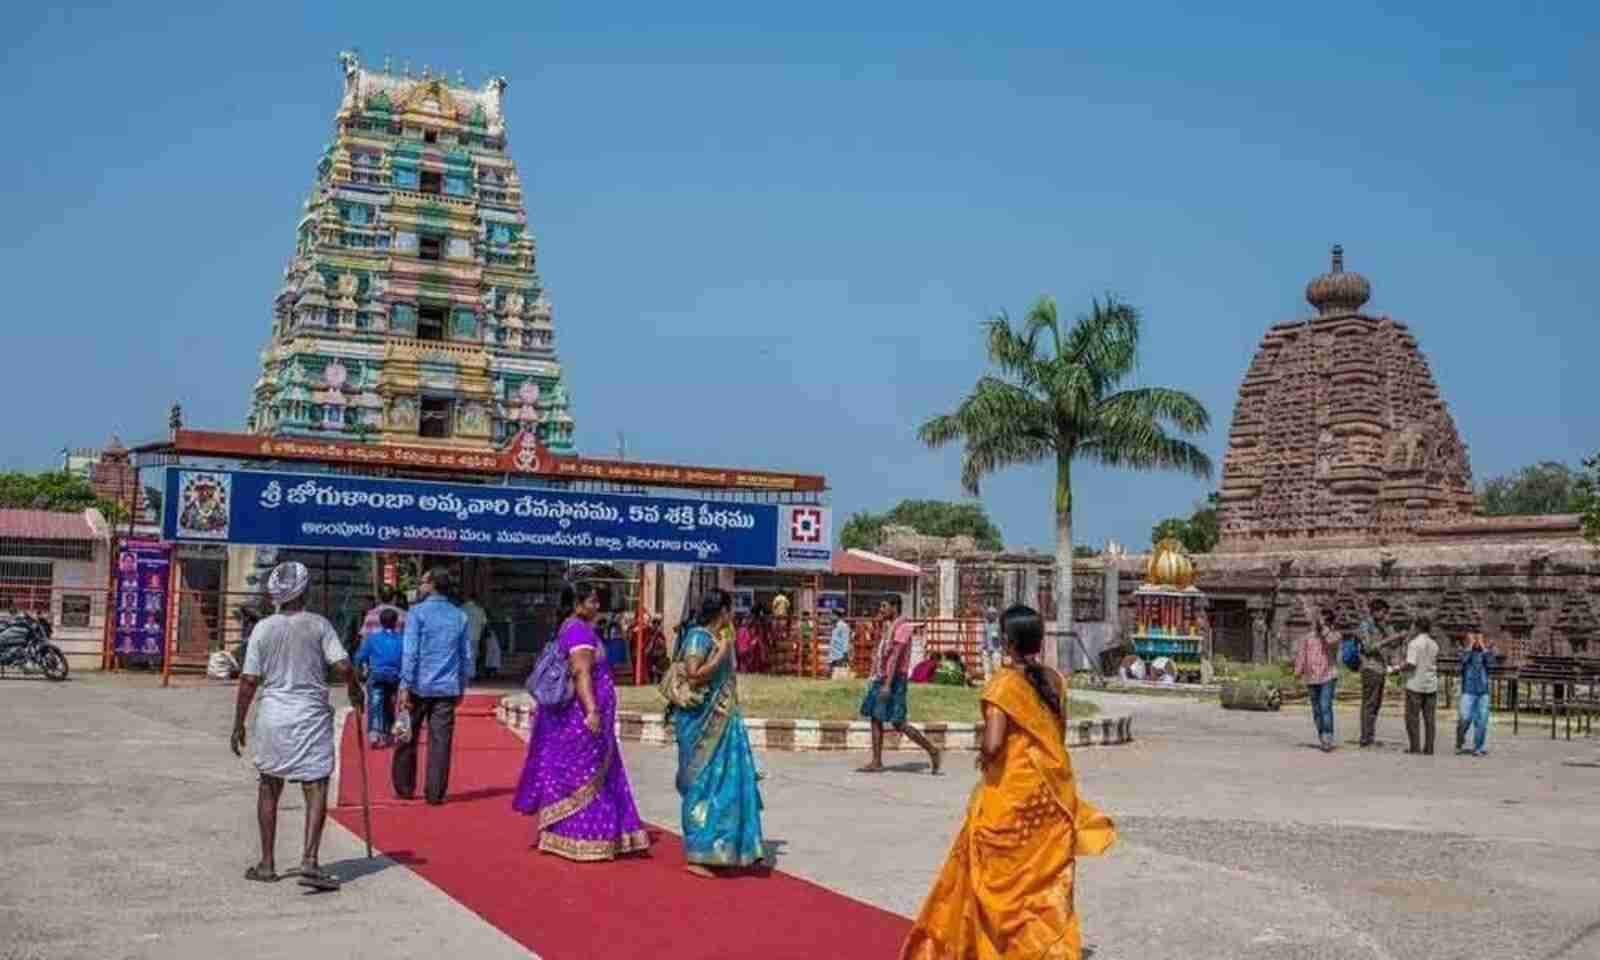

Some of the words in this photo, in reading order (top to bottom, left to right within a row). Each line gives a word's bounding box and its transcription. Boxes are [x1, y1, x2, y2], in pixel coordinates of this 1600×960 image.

[259, 480, 282, 508] శ్రీ
[418, 492, 510, 520] అమ్మవారి
[629, 504, 660, 524] 5వ
[664, 505, 696, 530] శక్తి
[698, 504, 756, 531] పీఠము
